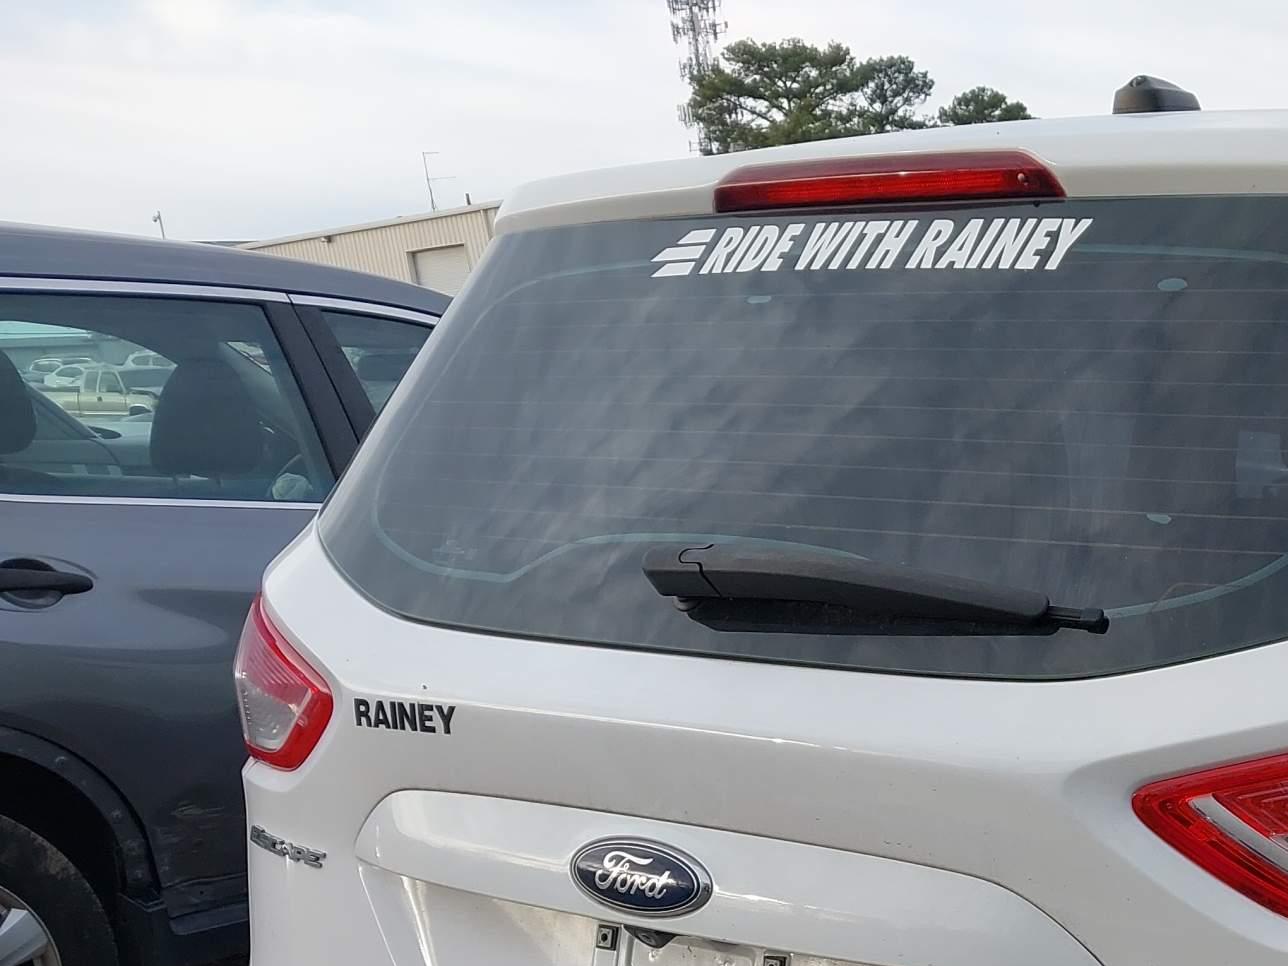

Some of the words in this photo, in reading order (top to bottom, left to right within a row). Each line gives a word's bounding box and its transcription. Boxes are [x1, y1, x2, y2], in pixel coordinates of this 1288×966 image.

[699, 224, 803, 274] RIDE
[795, 219, 912, 270] WITH
[905, 217, 1094, 270] RAINEY
[354, 698, 456, 735] RAINEY
[594, 850, 669, 899] Ford
